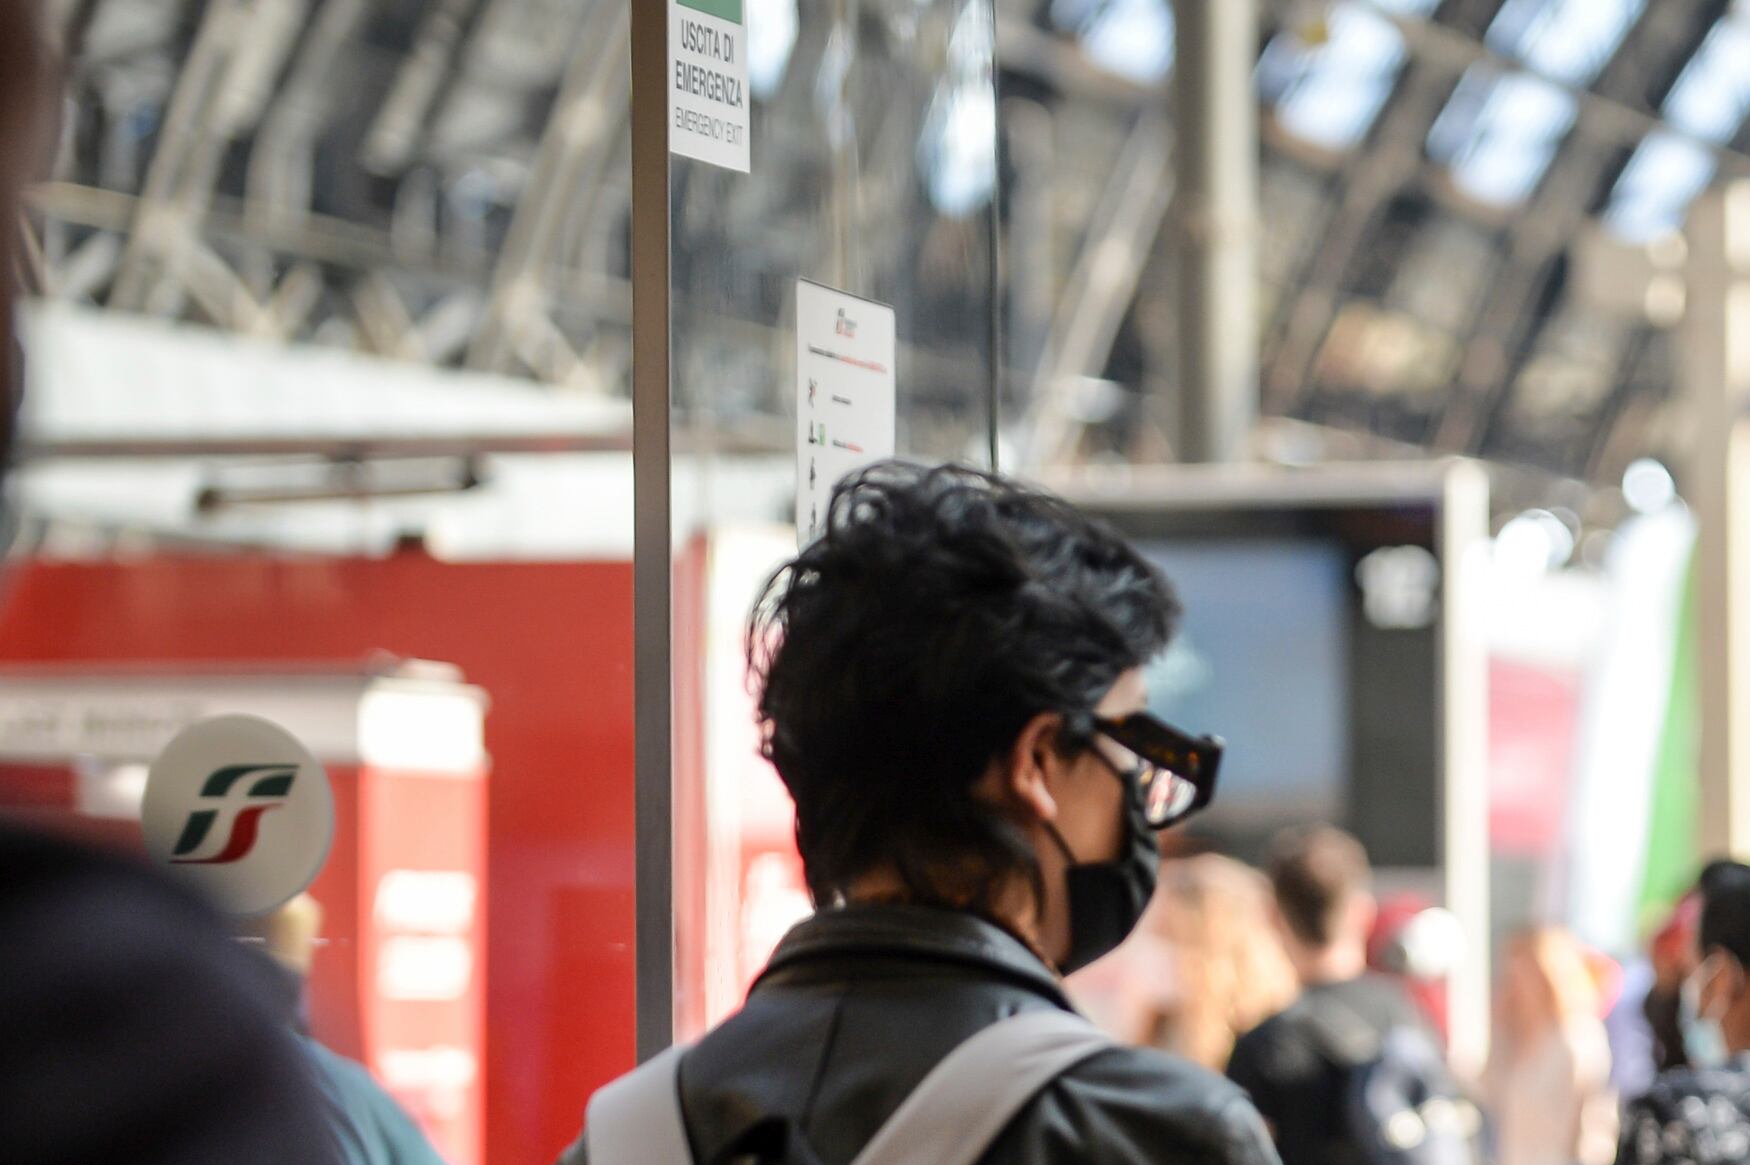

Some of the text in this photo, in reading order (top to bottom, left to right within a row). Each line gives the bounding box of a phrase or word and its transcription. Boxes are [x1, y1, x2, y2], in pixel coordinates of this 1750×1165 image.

[681, 19, 735, 64] USCITA DI
[675, 60, 744, 109] EMERGENZA
[675, 106, 744, 147] EMERGENCY EXIT
